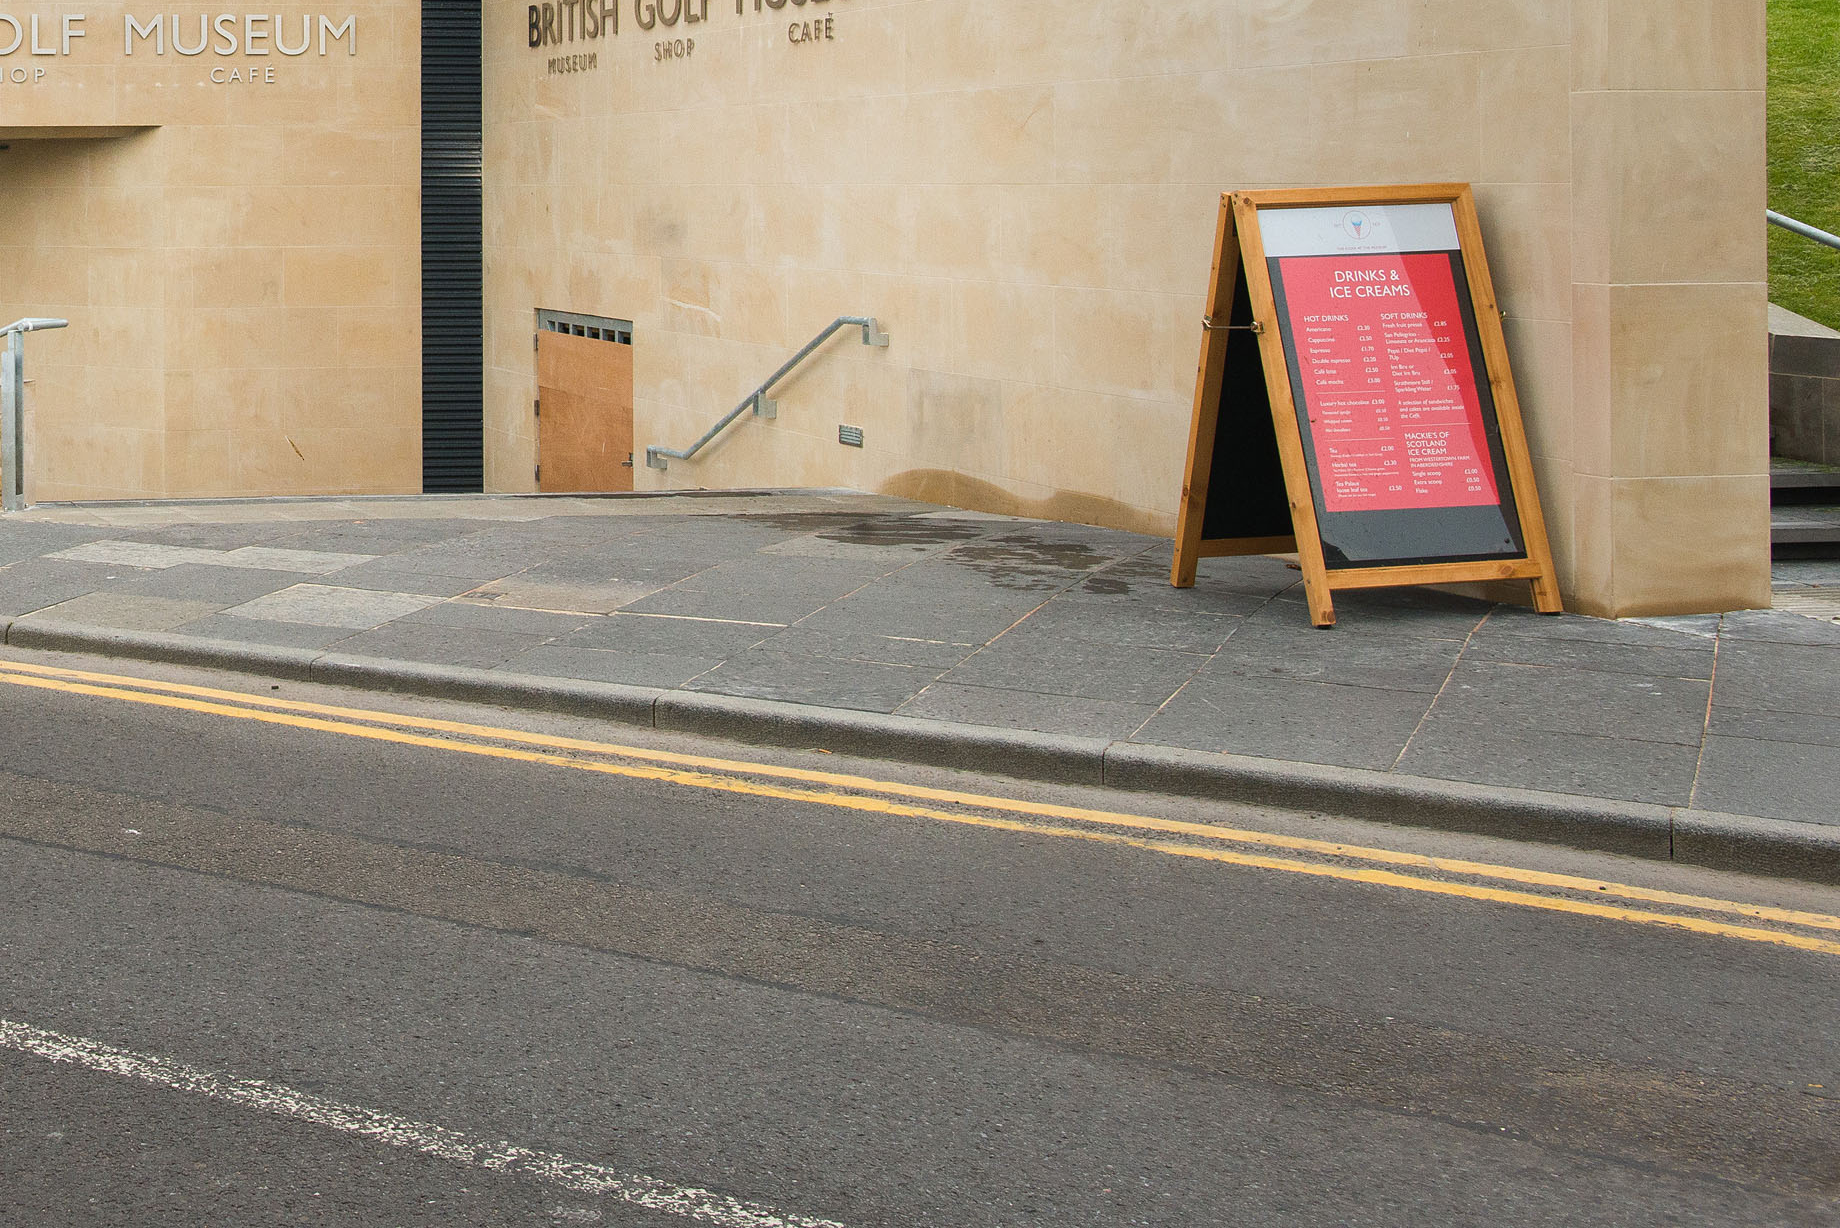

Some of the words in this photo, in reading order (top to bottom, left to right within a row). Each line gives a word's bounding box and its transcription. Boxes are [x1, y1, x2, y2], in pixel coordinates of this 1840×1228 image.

[122, 14, 358, 57] MUSEUM
[548, 52, 598, 74] MUSEUM
[654, 38, 695, 62] SHOP
[788, 12, 835, 45] CAFÉ
[210, 62, 277, 84] CAFÉ
[1334, 269, 1386, 282] DRINKS
[1390, 269, 1400, 280] &
[1329, 286, 1352, 298] ICE
[1355, 284, 1410, 298] CREAMS
